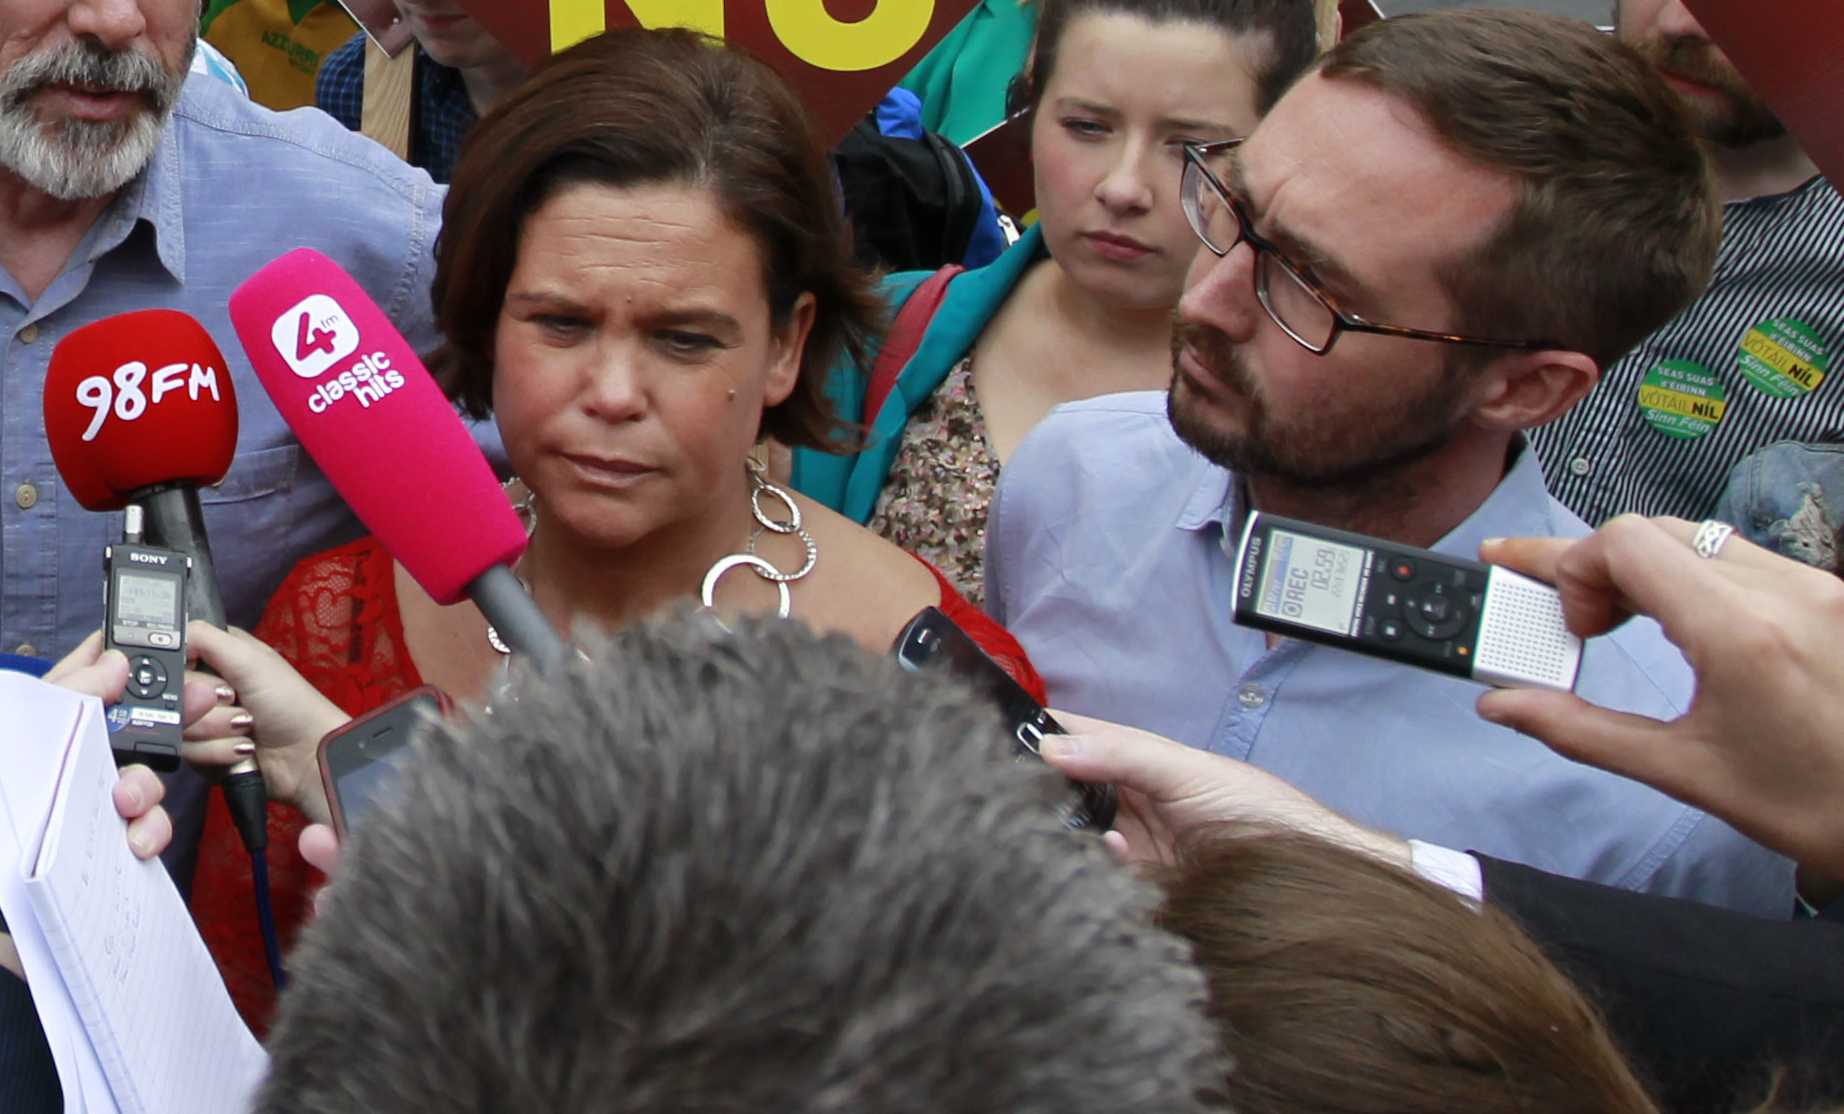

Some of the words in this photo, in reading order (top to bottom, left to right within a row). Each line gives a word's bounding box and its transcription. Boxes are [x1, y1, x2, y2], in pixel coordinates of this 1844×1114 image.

[296, 312, 337, 361] 4
[1772, 319, 1799, 338] SEAS
[1797, 334, 1824, 356] SUAS
[308, 351, 391, 413] classic
[353, 370, 405, 408] hits
[1658, 366, 1684, 380] SEAS
[1686, 372, 1714, 387] SUAS
[1739, 353, 1771, 378] Sinn
[1770, 375, 1801, 397] Féin
[1788, 363, 1816, 388] NÍL
[76, 361, 221, 441] 98FM
[1692, 400, 1719, 420] NÍL
[1646, 408, 1677, 426] Sinn
[1680, 416, 1710, 434] Féin
[130, 552, 168, 565] SONY
[1241, 537, 1262, 599] OLYMPUS
[1286, 567, 1309, 604] REC
